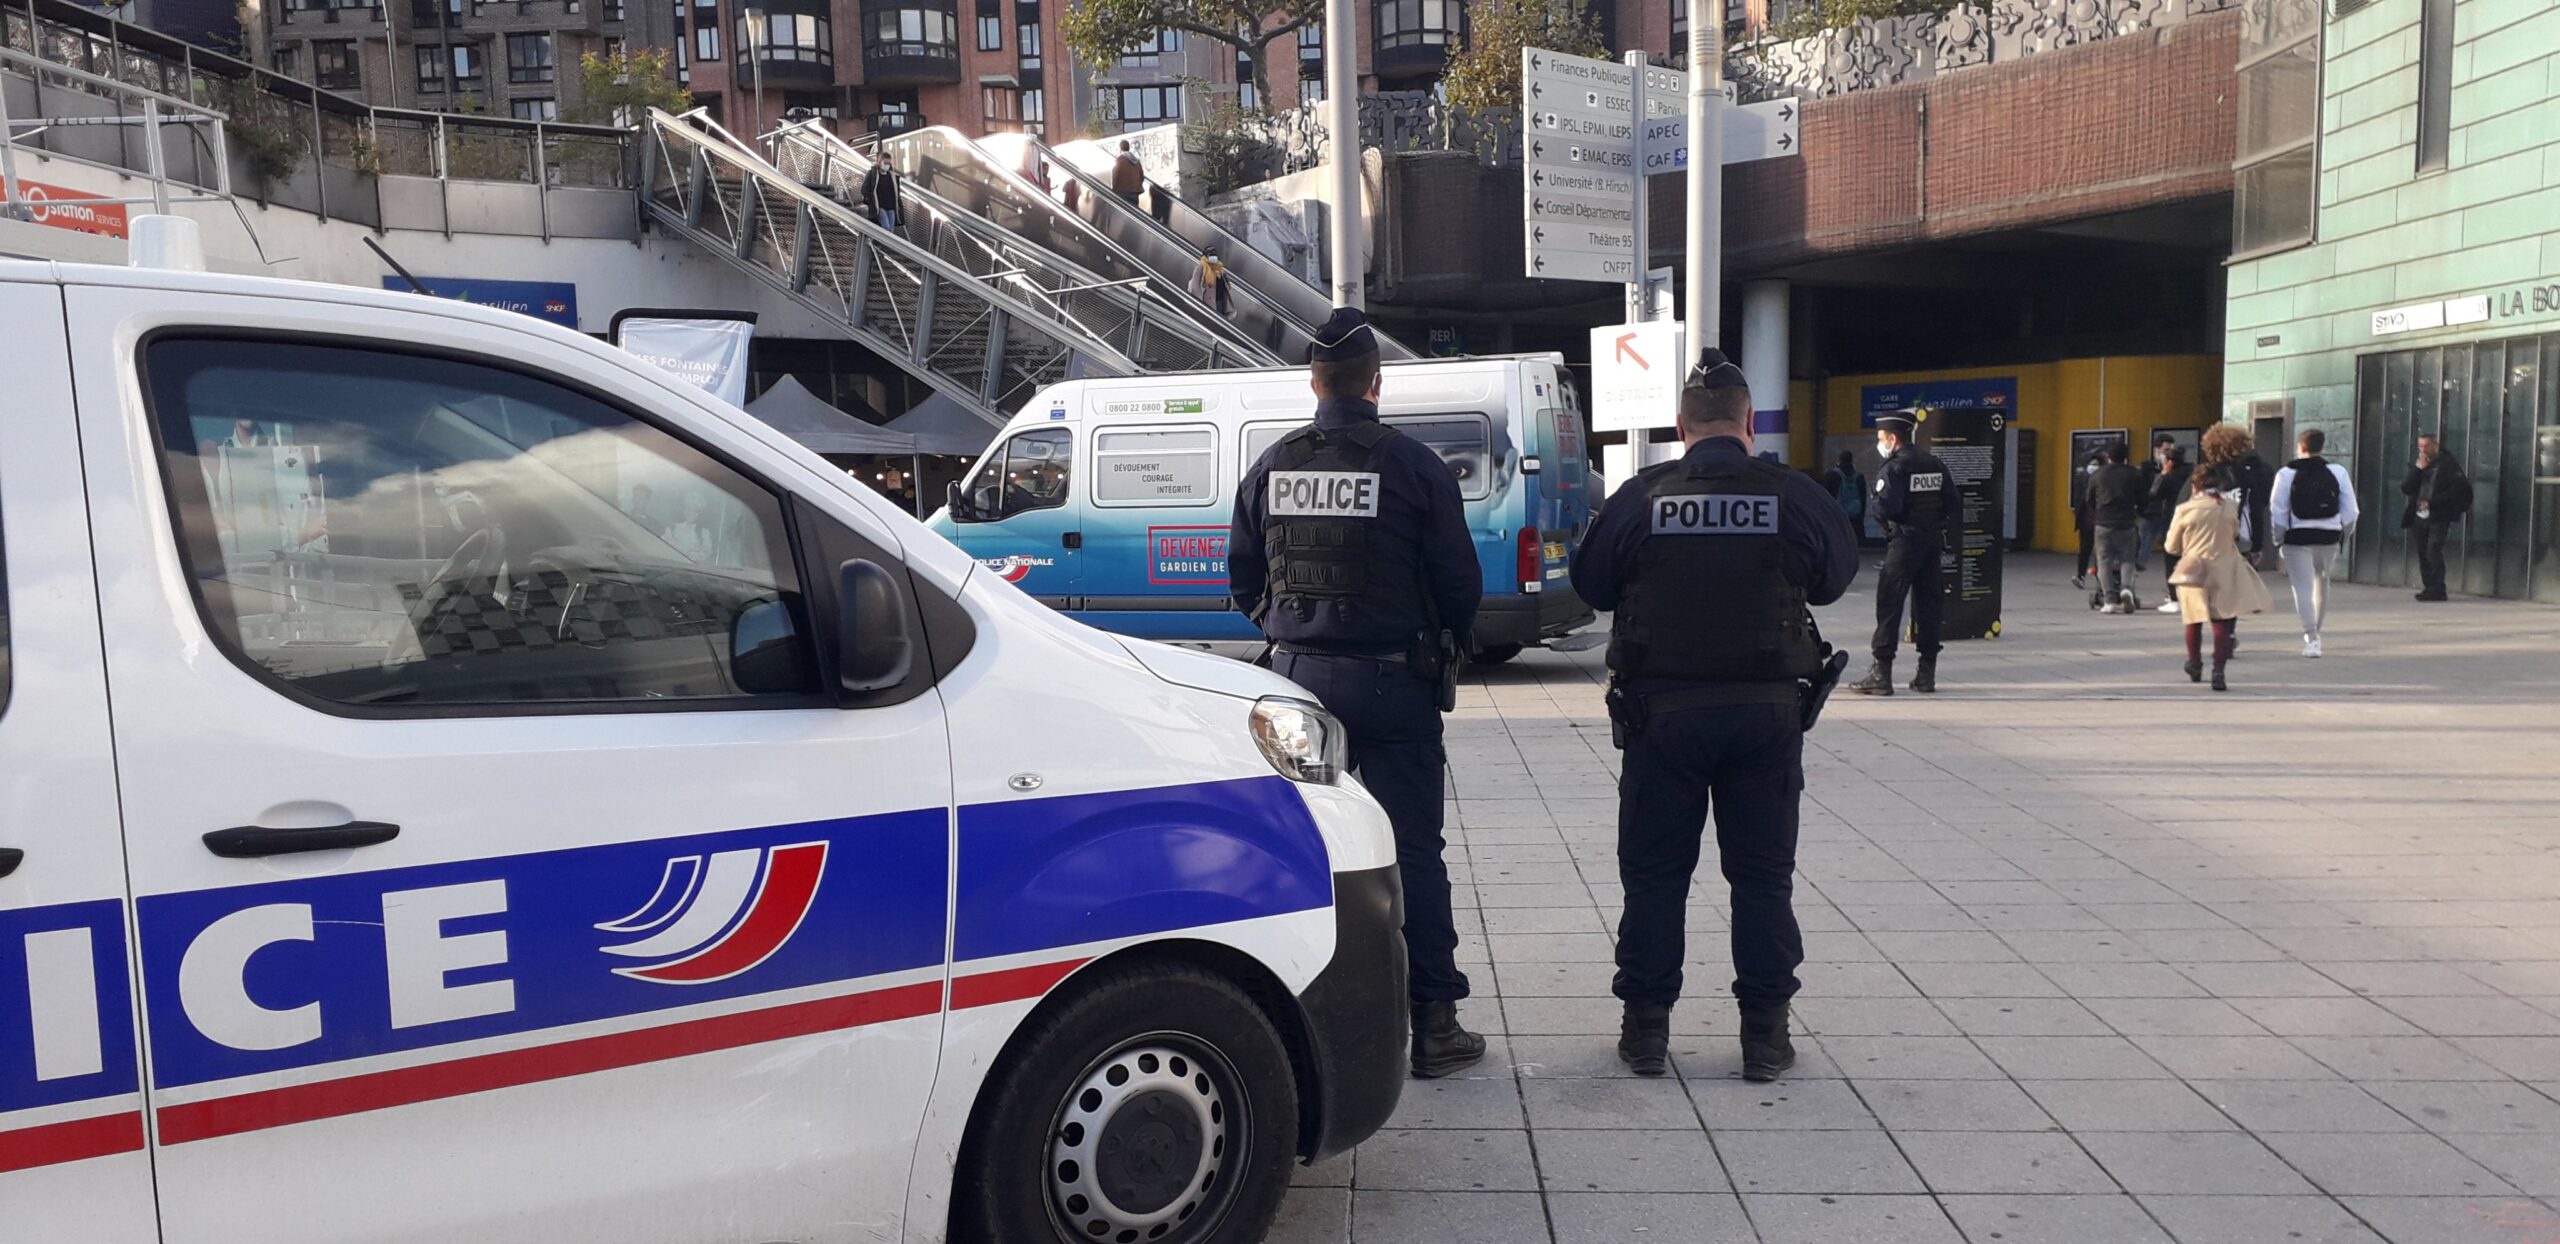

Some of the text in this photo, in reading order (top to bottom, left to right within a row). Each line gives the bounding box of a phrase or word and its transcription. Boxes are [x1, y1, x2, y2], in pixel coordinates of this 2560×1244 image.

[1551, 59, 1589, 78] Finances
[1591, 66, 1631, 86] Publiques
[1605, 96, 1631, 112] ESSEC
[1560, 117, 1632, 140] IPSL, EPMI, ILEPS
[1647, 123, 1680, 141] APEC
[1582, 148, 1632, 167] EMAC, EPSS
[1646, 152, 1671, 168] CAF
[1549, 173, 1593, 190] Université
[1605, 179, 1632, 194] Hirsch)
[1546, 200, 1632, 221] Conseil Départemental
[1588, 232, 1632, 248] Théâtre 95
[1603, 260, 1632, 274] CNFPT
[2499, 290, 2525, 318] LA
[1431, 329, 1451, 342] RER
[1109, 403, 1161, 413] 0800 22 0800
[1114, 463, 1161, 472] DÉVOUEMENT
[1142, 474, 1173, 483] COURAGE
[1156, 484, 1192, 494] INTÉGRITÉ
[1275, 477, 1372, 510] POLICE
[1660, 499, 1770, 528] POLICE
[1160, 537, 1226, 558] DEVENEZ
[1004, 558, 1054, 566] NATIONALE
[1160, 561, 1225, 572] GARDIEN DE
